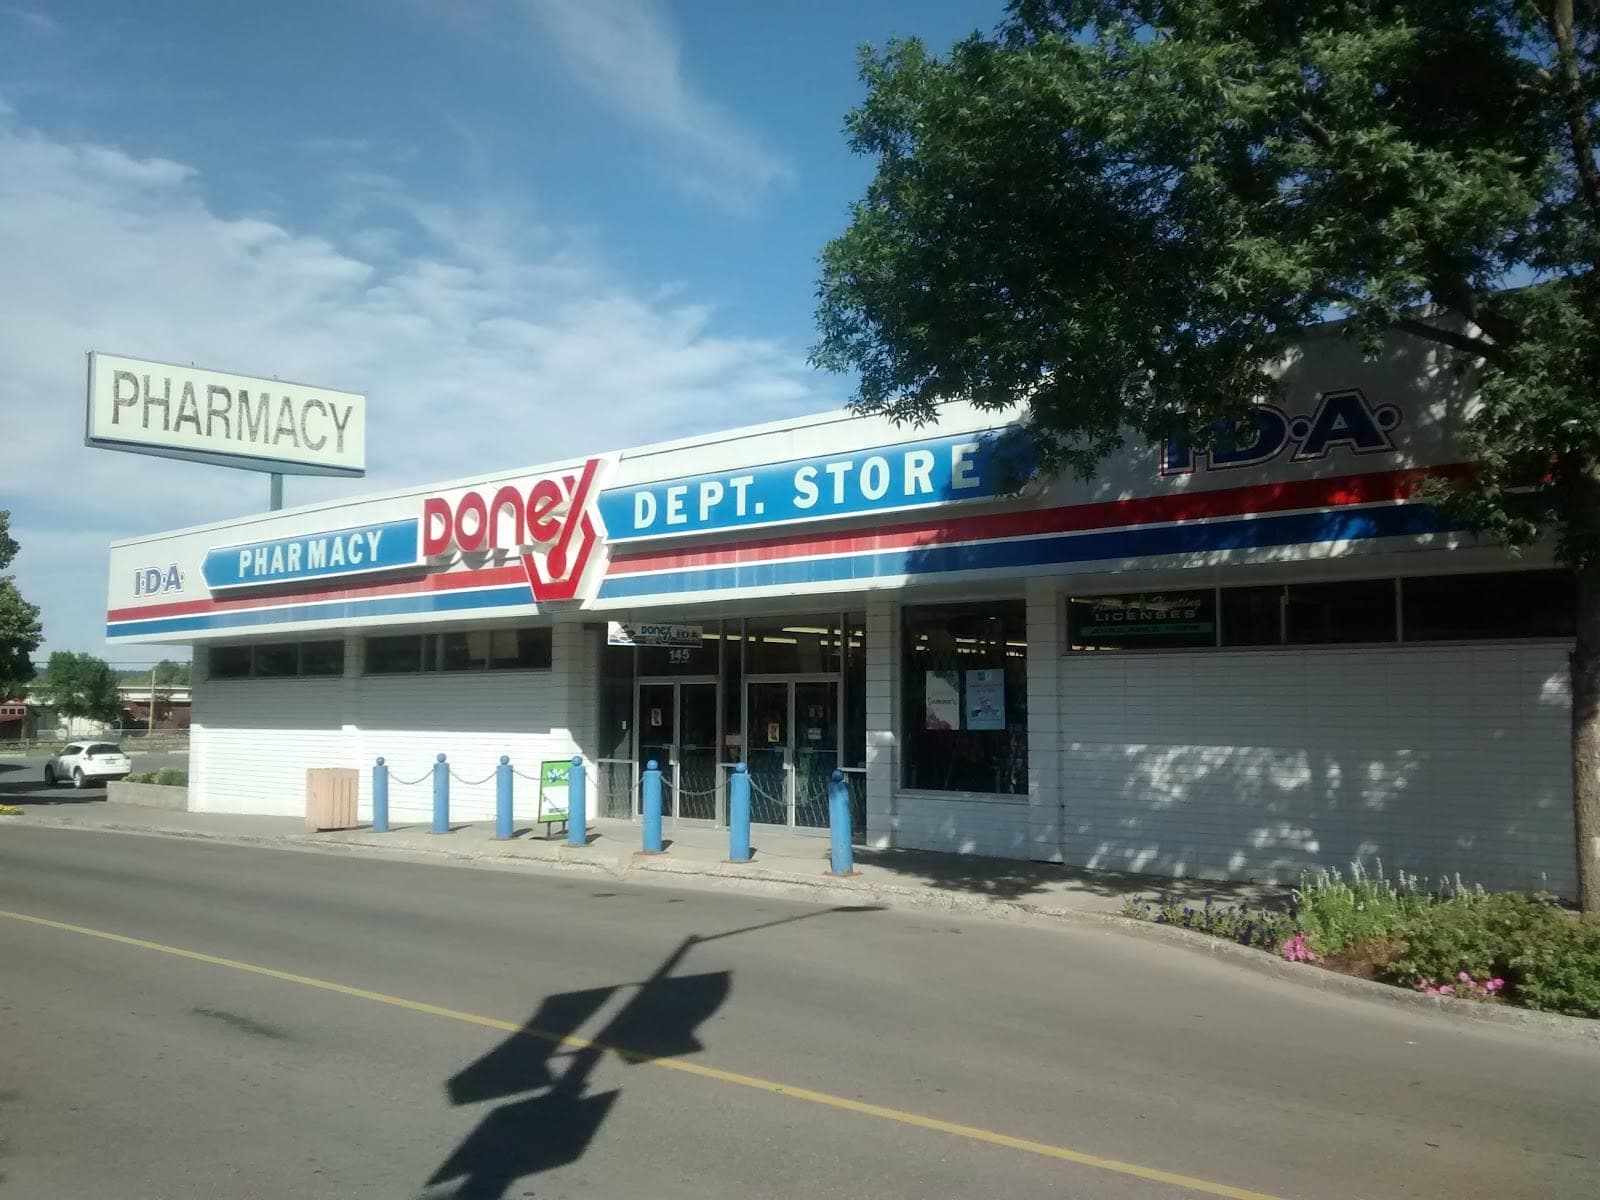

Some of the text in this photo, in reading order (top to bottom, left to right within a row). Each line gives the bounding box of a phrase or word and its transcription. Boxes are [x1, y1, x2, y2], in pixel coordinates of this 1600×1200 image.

[111, 369, 352, 453] PHARMACY
[634, 443, 980, 529] DEPT. STORE
[238, 529, 383, 578] PHARMACY
[1095, 608, 1196, 622] LICENSES
